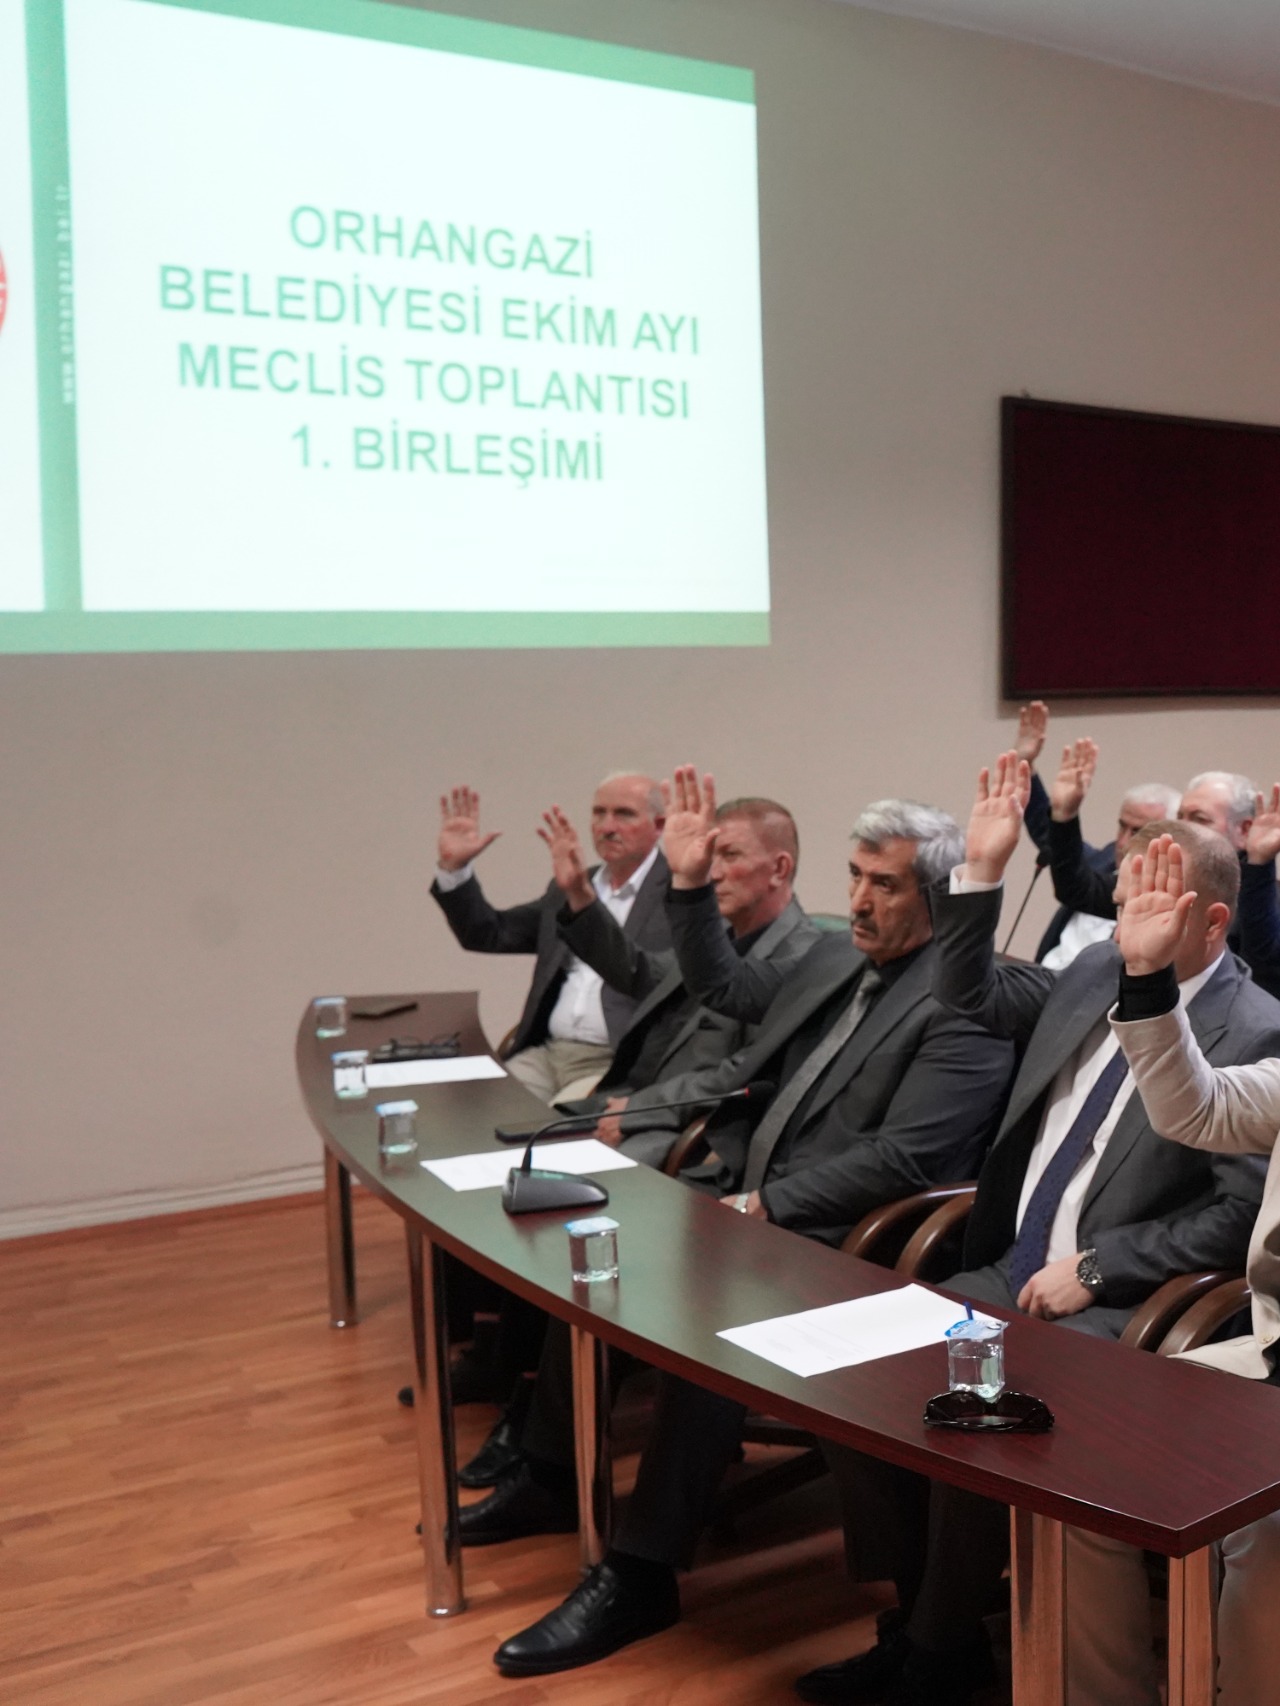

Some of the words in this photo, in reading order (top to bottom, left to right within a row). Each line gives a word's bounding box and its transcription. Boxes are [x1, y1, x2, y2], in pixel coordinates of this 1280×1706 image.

[289, 204, 594, 277] ORHANGAZİ
[159, 264, 481, 336] BELEDİYESİ
[502, 296, 617, 347] EKİM
[632, 311, 700, 356] AYI
[178, 342, 385, 399] MECLİS
[404, 358, 690, 419] TOPLANTISI
[292, 424, 332, 468] 1.
[353, 419, 604, 488] BİRLEŞİMİ
